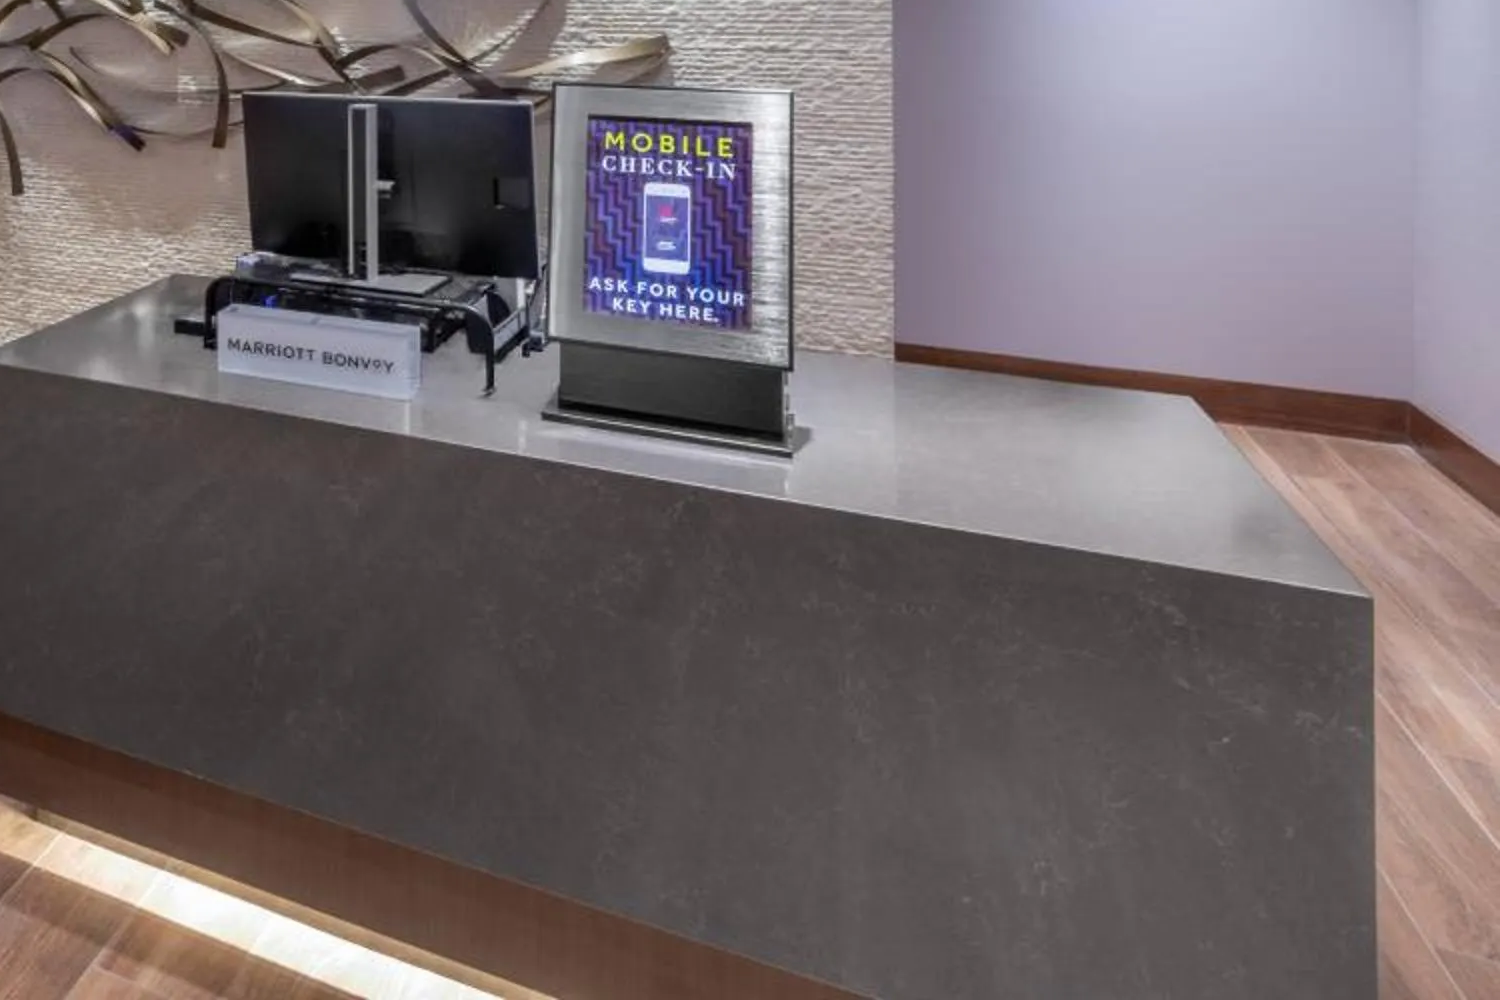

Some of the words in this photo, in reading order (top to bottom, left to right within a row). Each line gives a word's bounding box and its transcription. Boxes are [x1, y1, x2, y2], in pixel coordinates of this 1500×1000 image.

[604, 131, 734, 158] MOBILE
[602, 155, 737, 180] CHECK-IN
[589, 277, 629, 293] ASK
[636, 281, 678, 298] FOR
[686, 287, 745, 306] YOUR
[612, 298, 651, 314] KEY
[659, 303, 719, 323] HERE.
[226, 338, 315, 361] MARRIOTT
